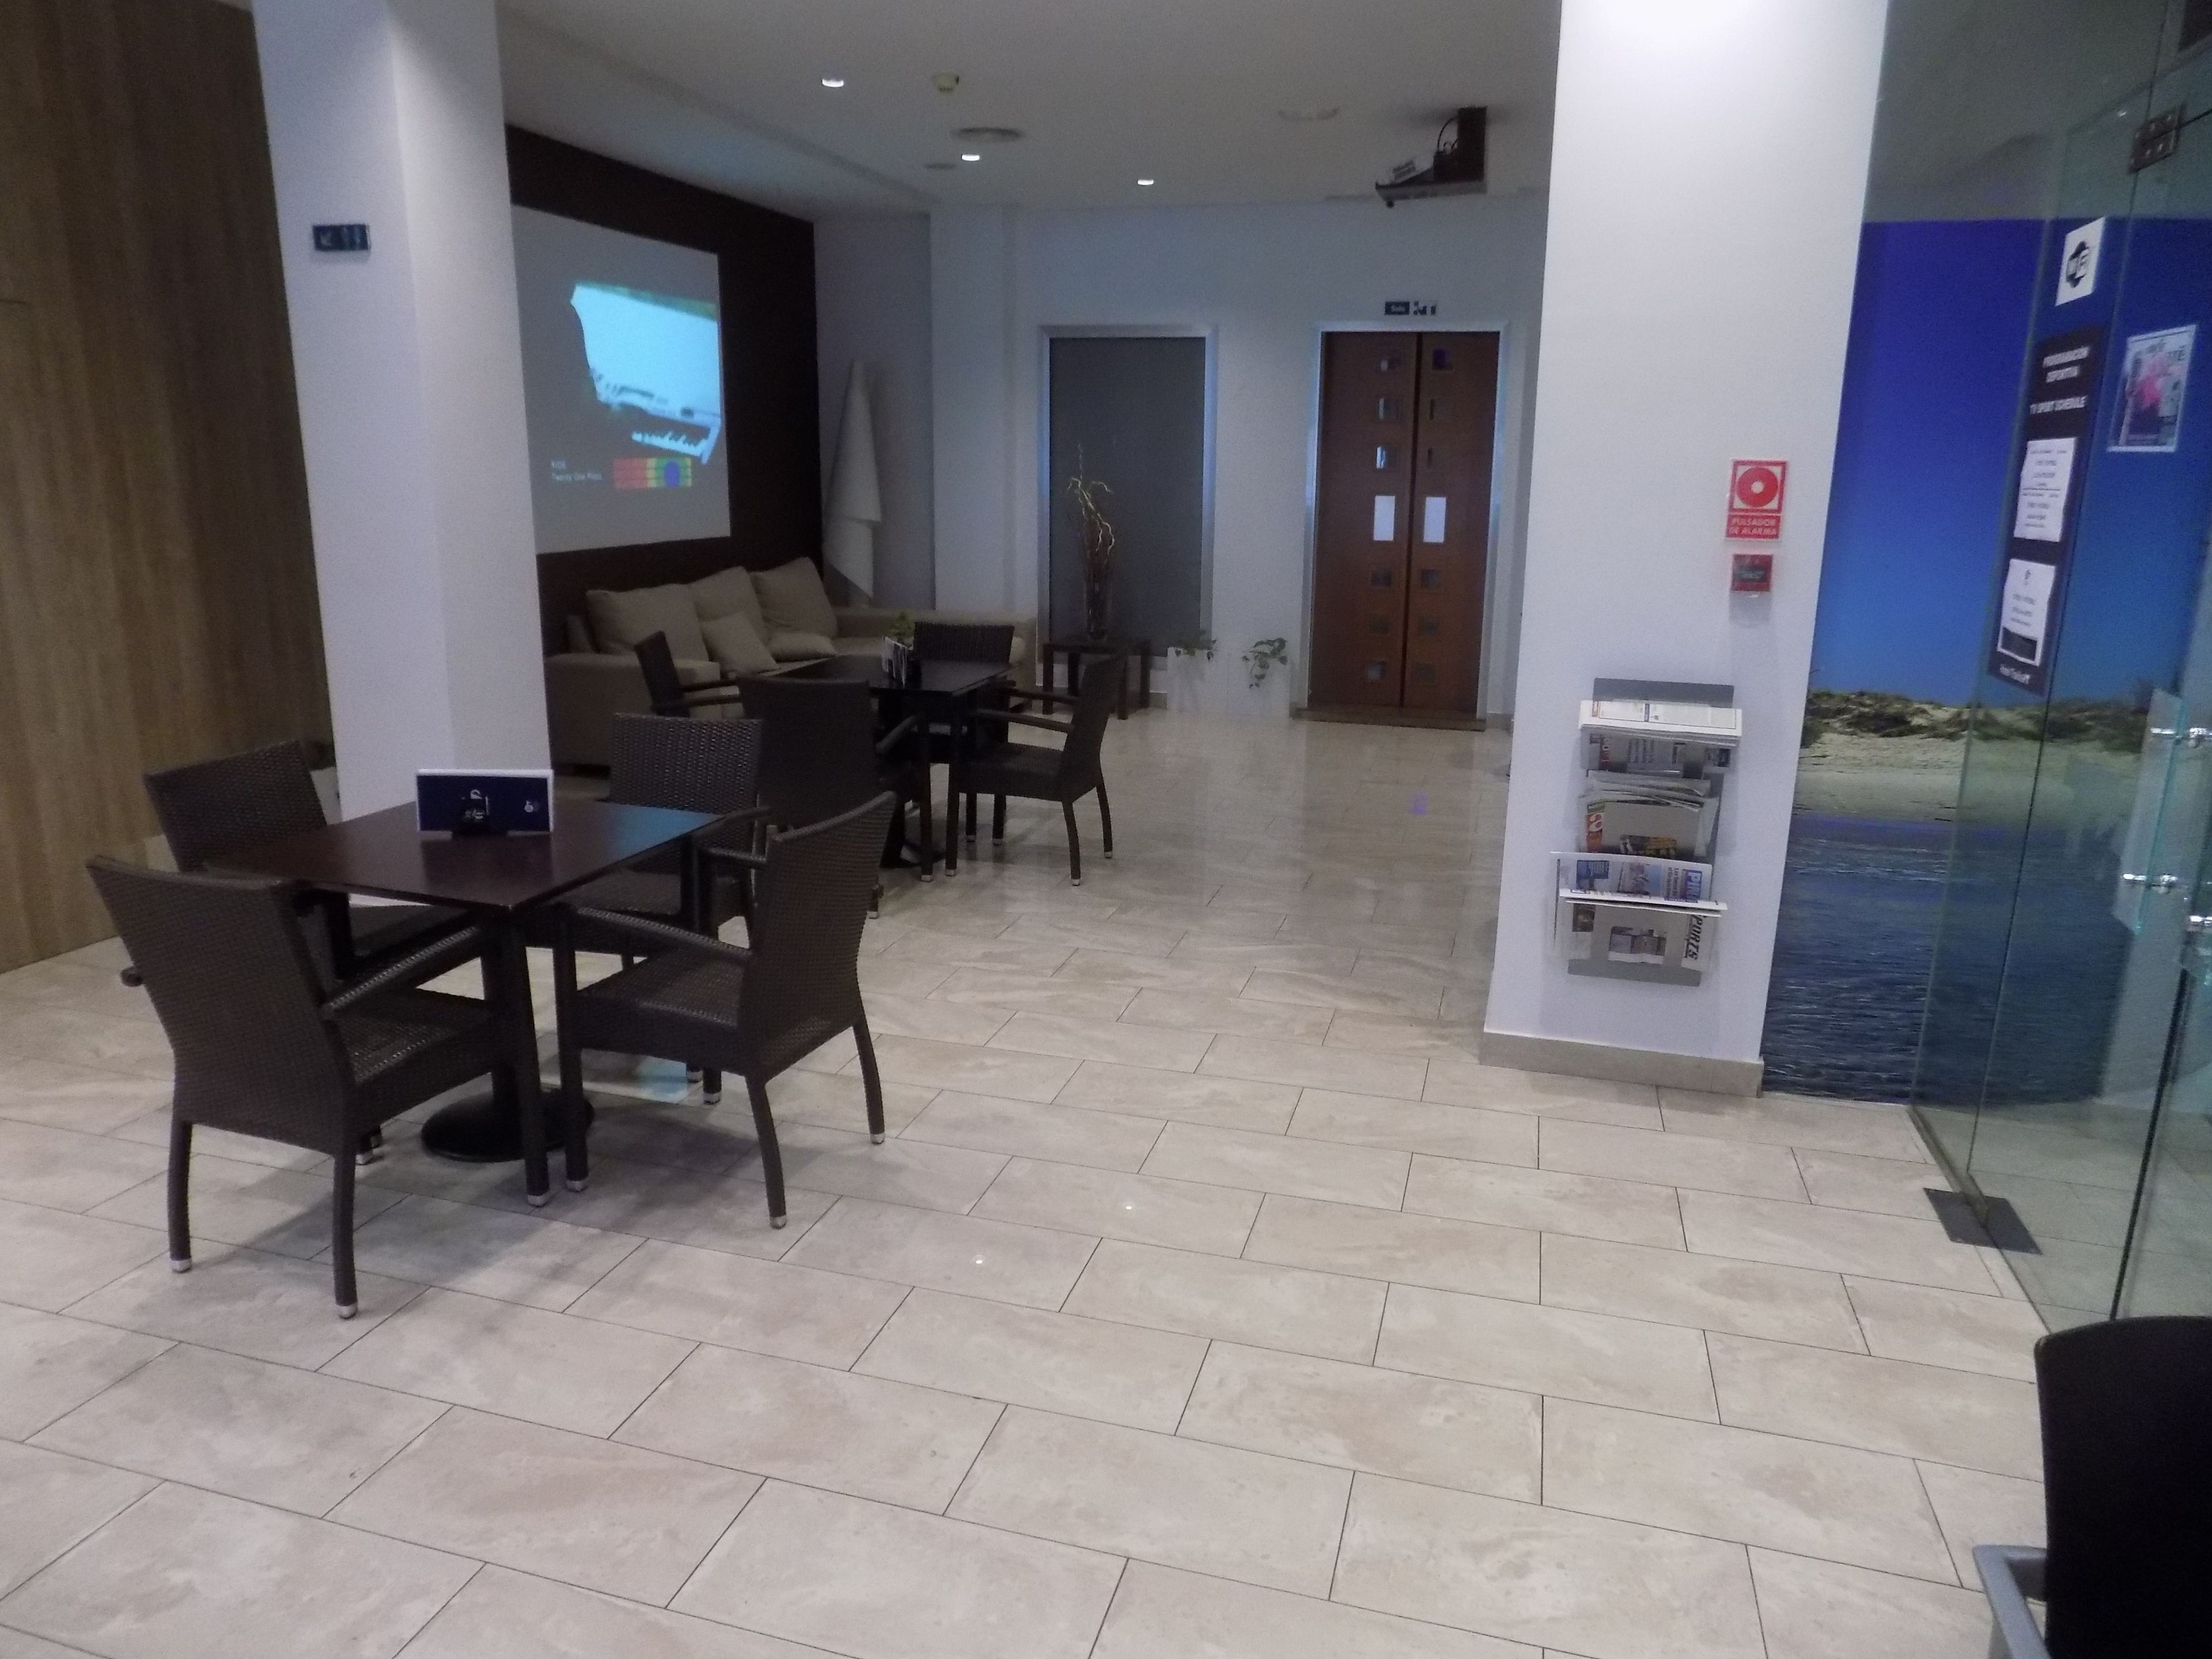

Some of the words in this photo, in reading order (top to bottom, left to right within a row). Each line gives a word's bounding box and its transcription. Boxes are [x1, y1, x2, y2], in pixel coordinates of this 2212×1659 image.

[1732, 517, 1777, 526] PULSADOR
[1740, 527, 1777, 536] ALARMA
[1688, 914, 1703, 960] PORTS
